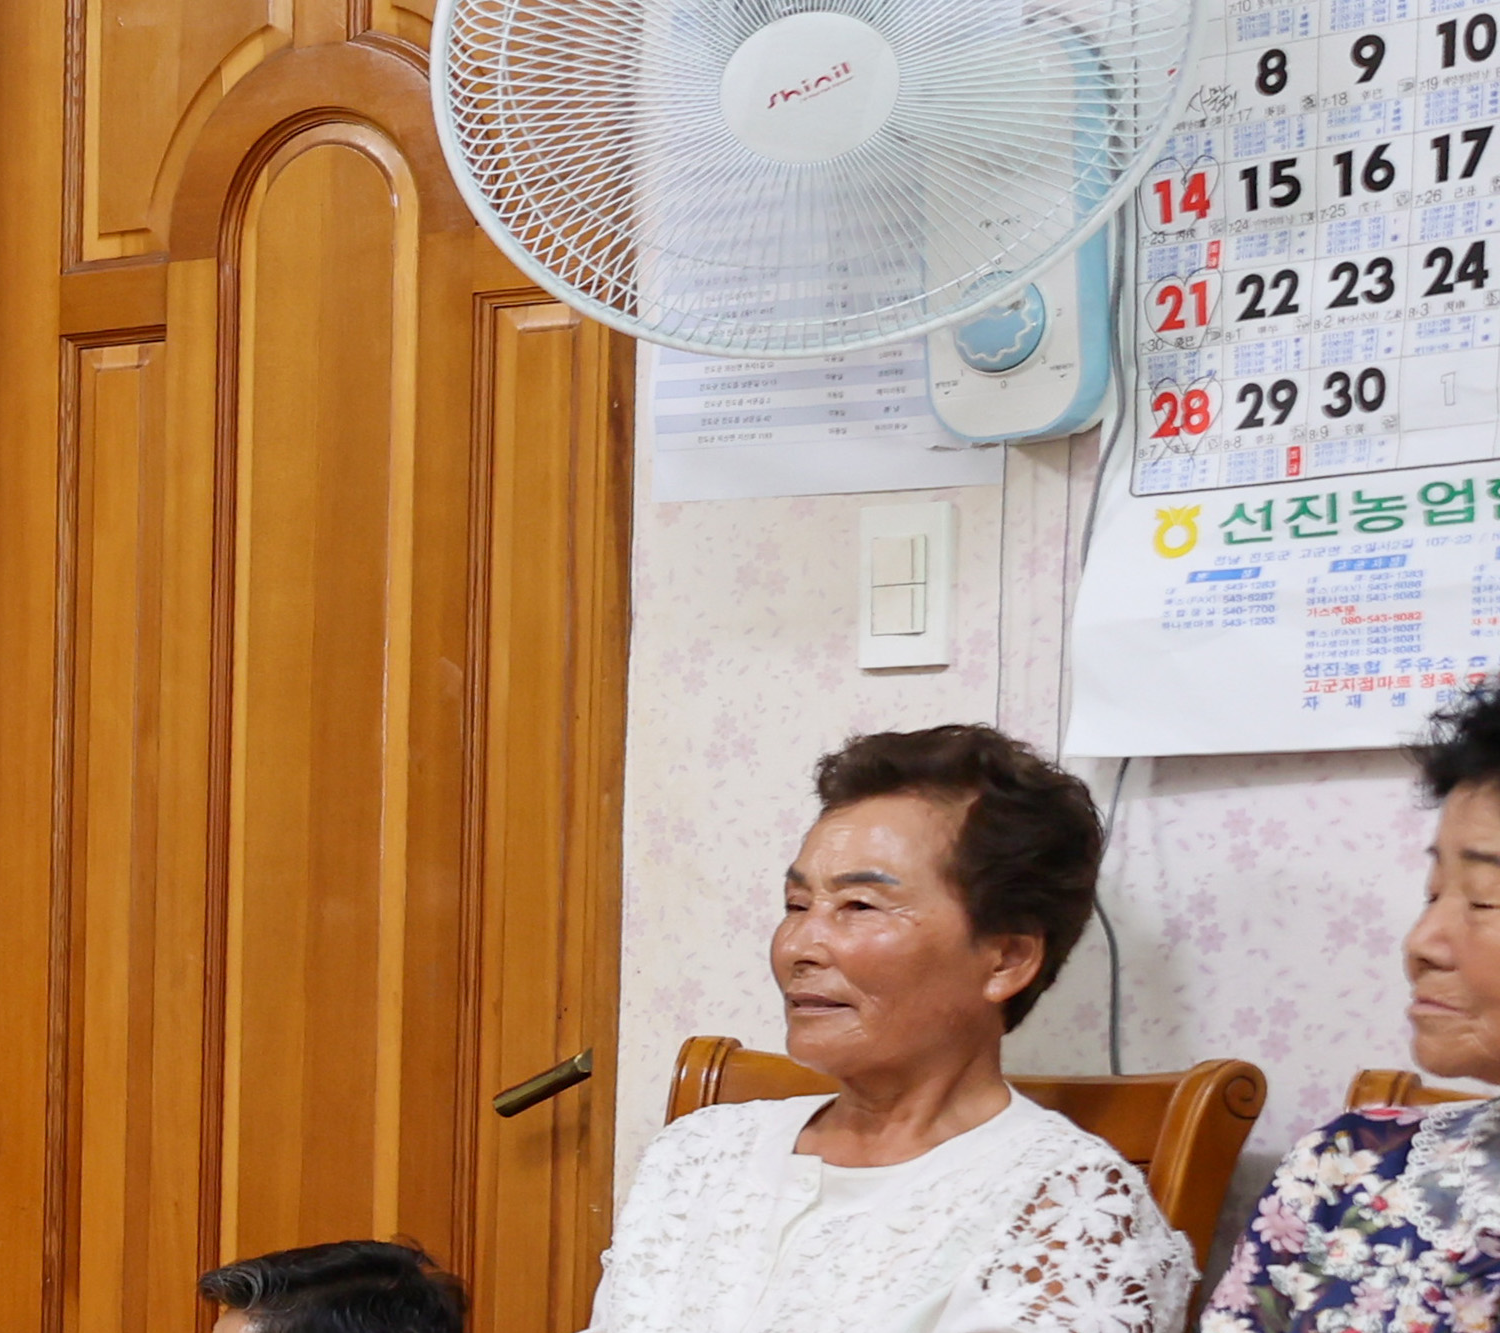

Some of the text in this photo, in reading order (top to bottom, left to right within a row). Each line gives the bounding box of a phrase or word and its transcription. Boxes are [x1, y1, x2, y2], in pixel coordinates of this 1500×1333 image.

[1255, 48, 1287, 96] 8
[1350, 34, 1386, 84] 9
[1437, 12, 1498, 69] 10
[1153, 125, 1494, 225] 14 15 16 17
[1154, 240, 1489, 334] 21 22 23 24
[1149, 389, 1211, 440] 28
[1234, 379, 1298, 432] 29
[1320, 367, 1386, 419] 30
[1219, 477, 1500, 546] 선진농업
[1303, 675, 1413, 694] 고군지점마트
[1395, 657, 1455, 672] 주유소
